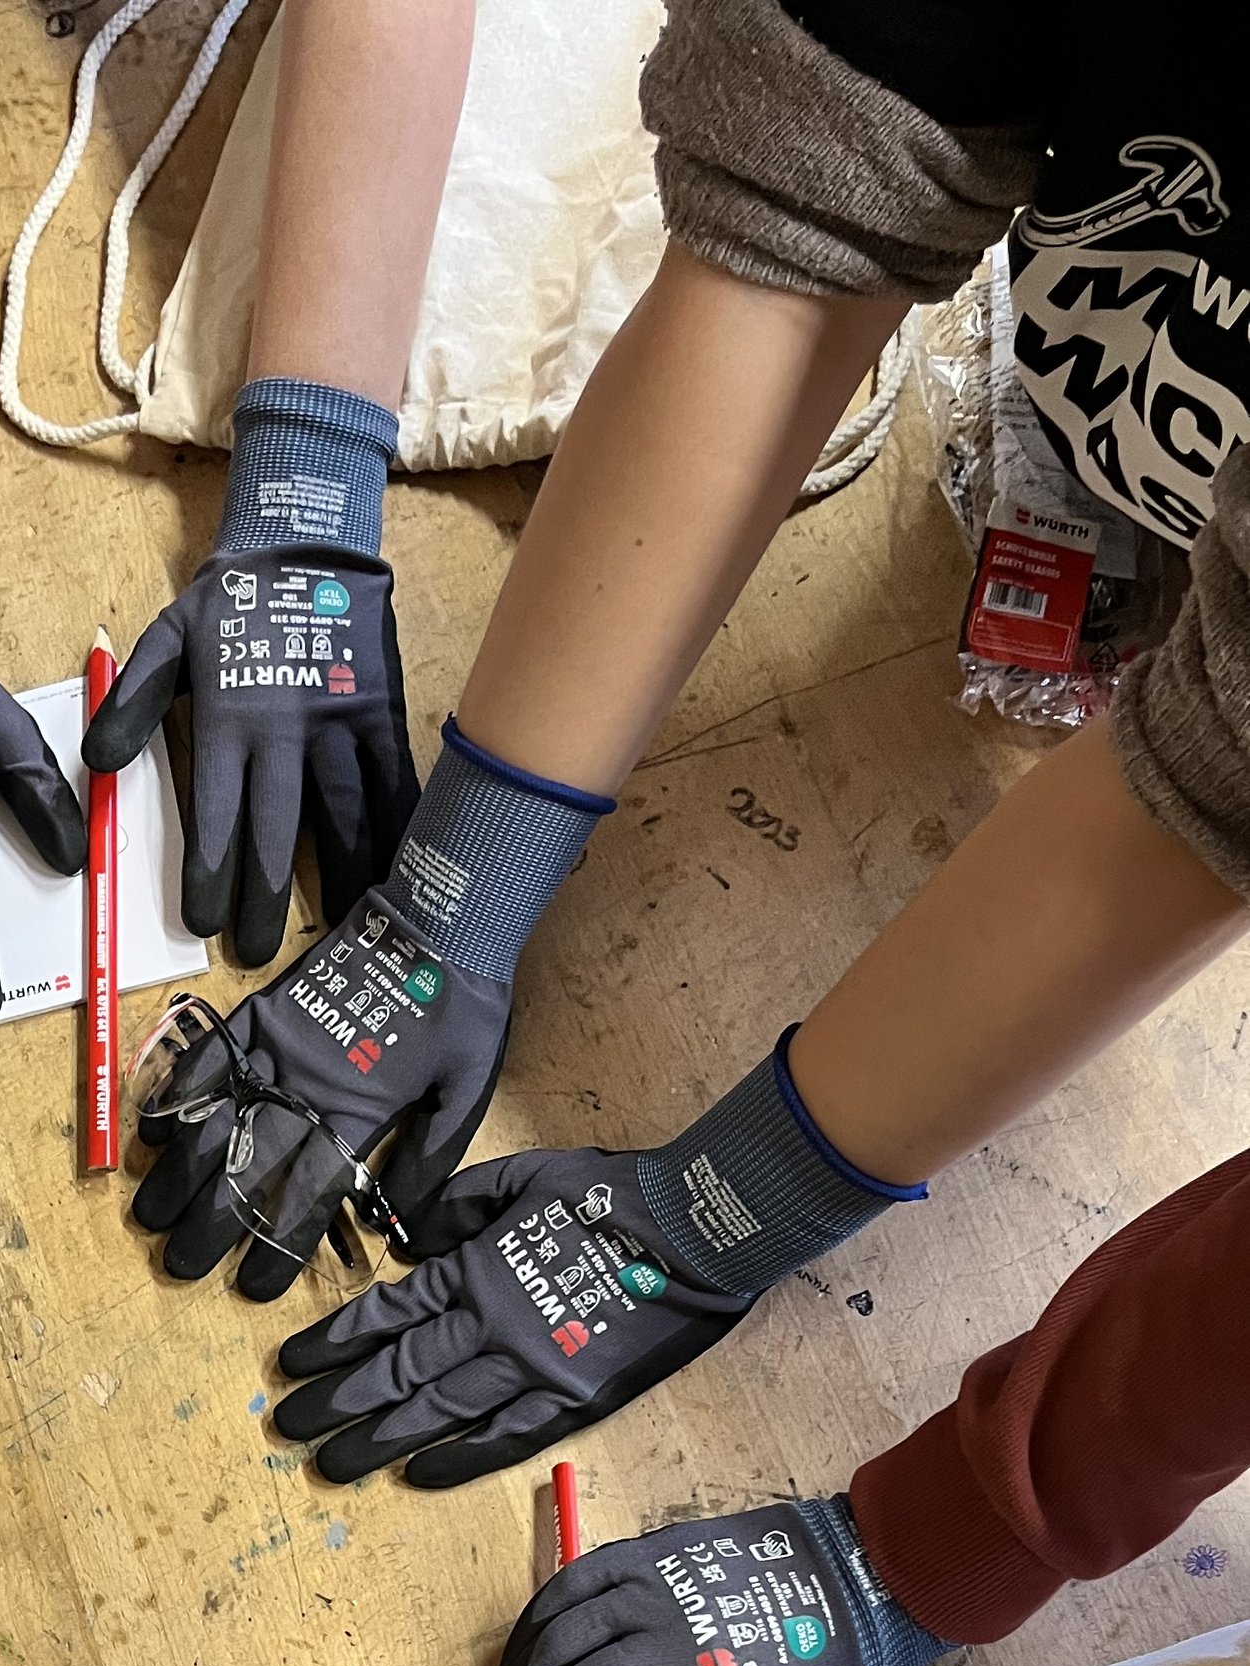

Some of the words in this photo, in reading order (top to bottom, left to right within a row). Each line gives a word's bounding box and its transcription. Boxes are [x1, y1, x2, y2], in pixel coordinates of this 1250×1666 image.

[1033, 515, 1090, 539] WÜRTH
[992, 555, 1024, 570] SAFETY
[219, 664, 323, 690] WÜRTH
[375, 950, 408, 982] STANDARD
[288, 978, 357, 1047] WÜRTH
[595, 1232, 626, 1269] STANDARD
[496, 1230, 566, 1325] WÜRTH
[655, 1553, 719, 1646] WÜRTH
